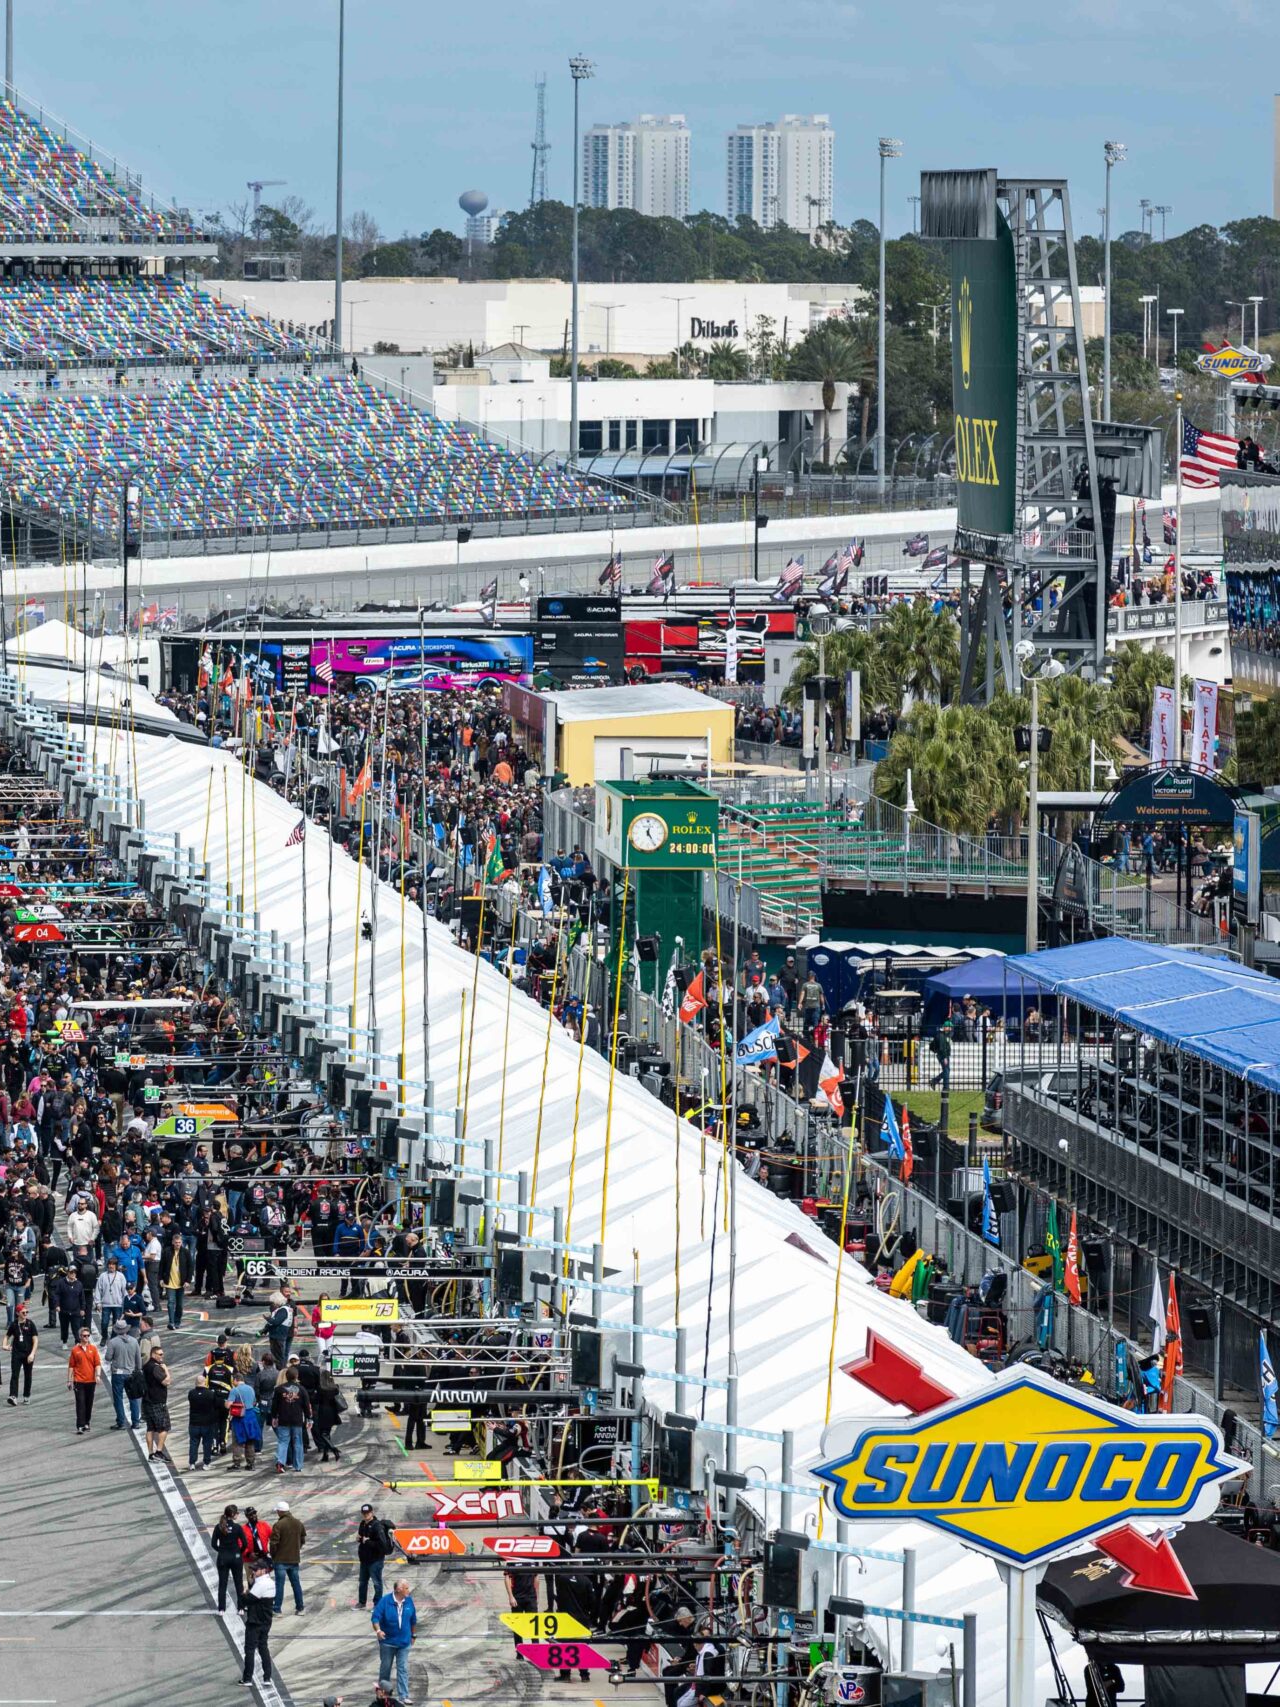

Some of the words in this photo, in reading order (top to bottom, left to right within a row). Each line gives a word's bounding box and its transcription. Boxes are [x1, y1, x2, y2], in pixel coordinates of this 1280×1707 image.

[1203, 358, 1258, 369] SUNOCO
[956, 414, 999, 486] OLEX
[1136, 806, 1179, 815] Welcome
[1182, 806, 1211, 815] home.
[672, 826, 711, 834] ROLEX
[670, 843, 715, 854] 24:00:00
[36, 929, 48, 937] 04
[145, 1088, 159, 1097] 91
[177, 1119, 195, 1133] 36
[229, 1237, 244, 1251] 38
[246, 1260, 266, 1275] 66
[320, 1268, 350, 1276] RACING
[394, 1269, 429, 1277] ACURA
[376, 1303, 394, 1316] 75
[337, 1358, 350, 1369] 78
[430, 1390, 487, 1403] ARROW
[853, 1441, 1201, 1503] SUNOCO
[431, 1535, 450, 1550] 80
[493, 1539, 553, 1552] 023
[529, 1615, 559, 1636] 19
[547, 1645, 580, 1667] 83
[839, 1681, 857, 1700] VP
